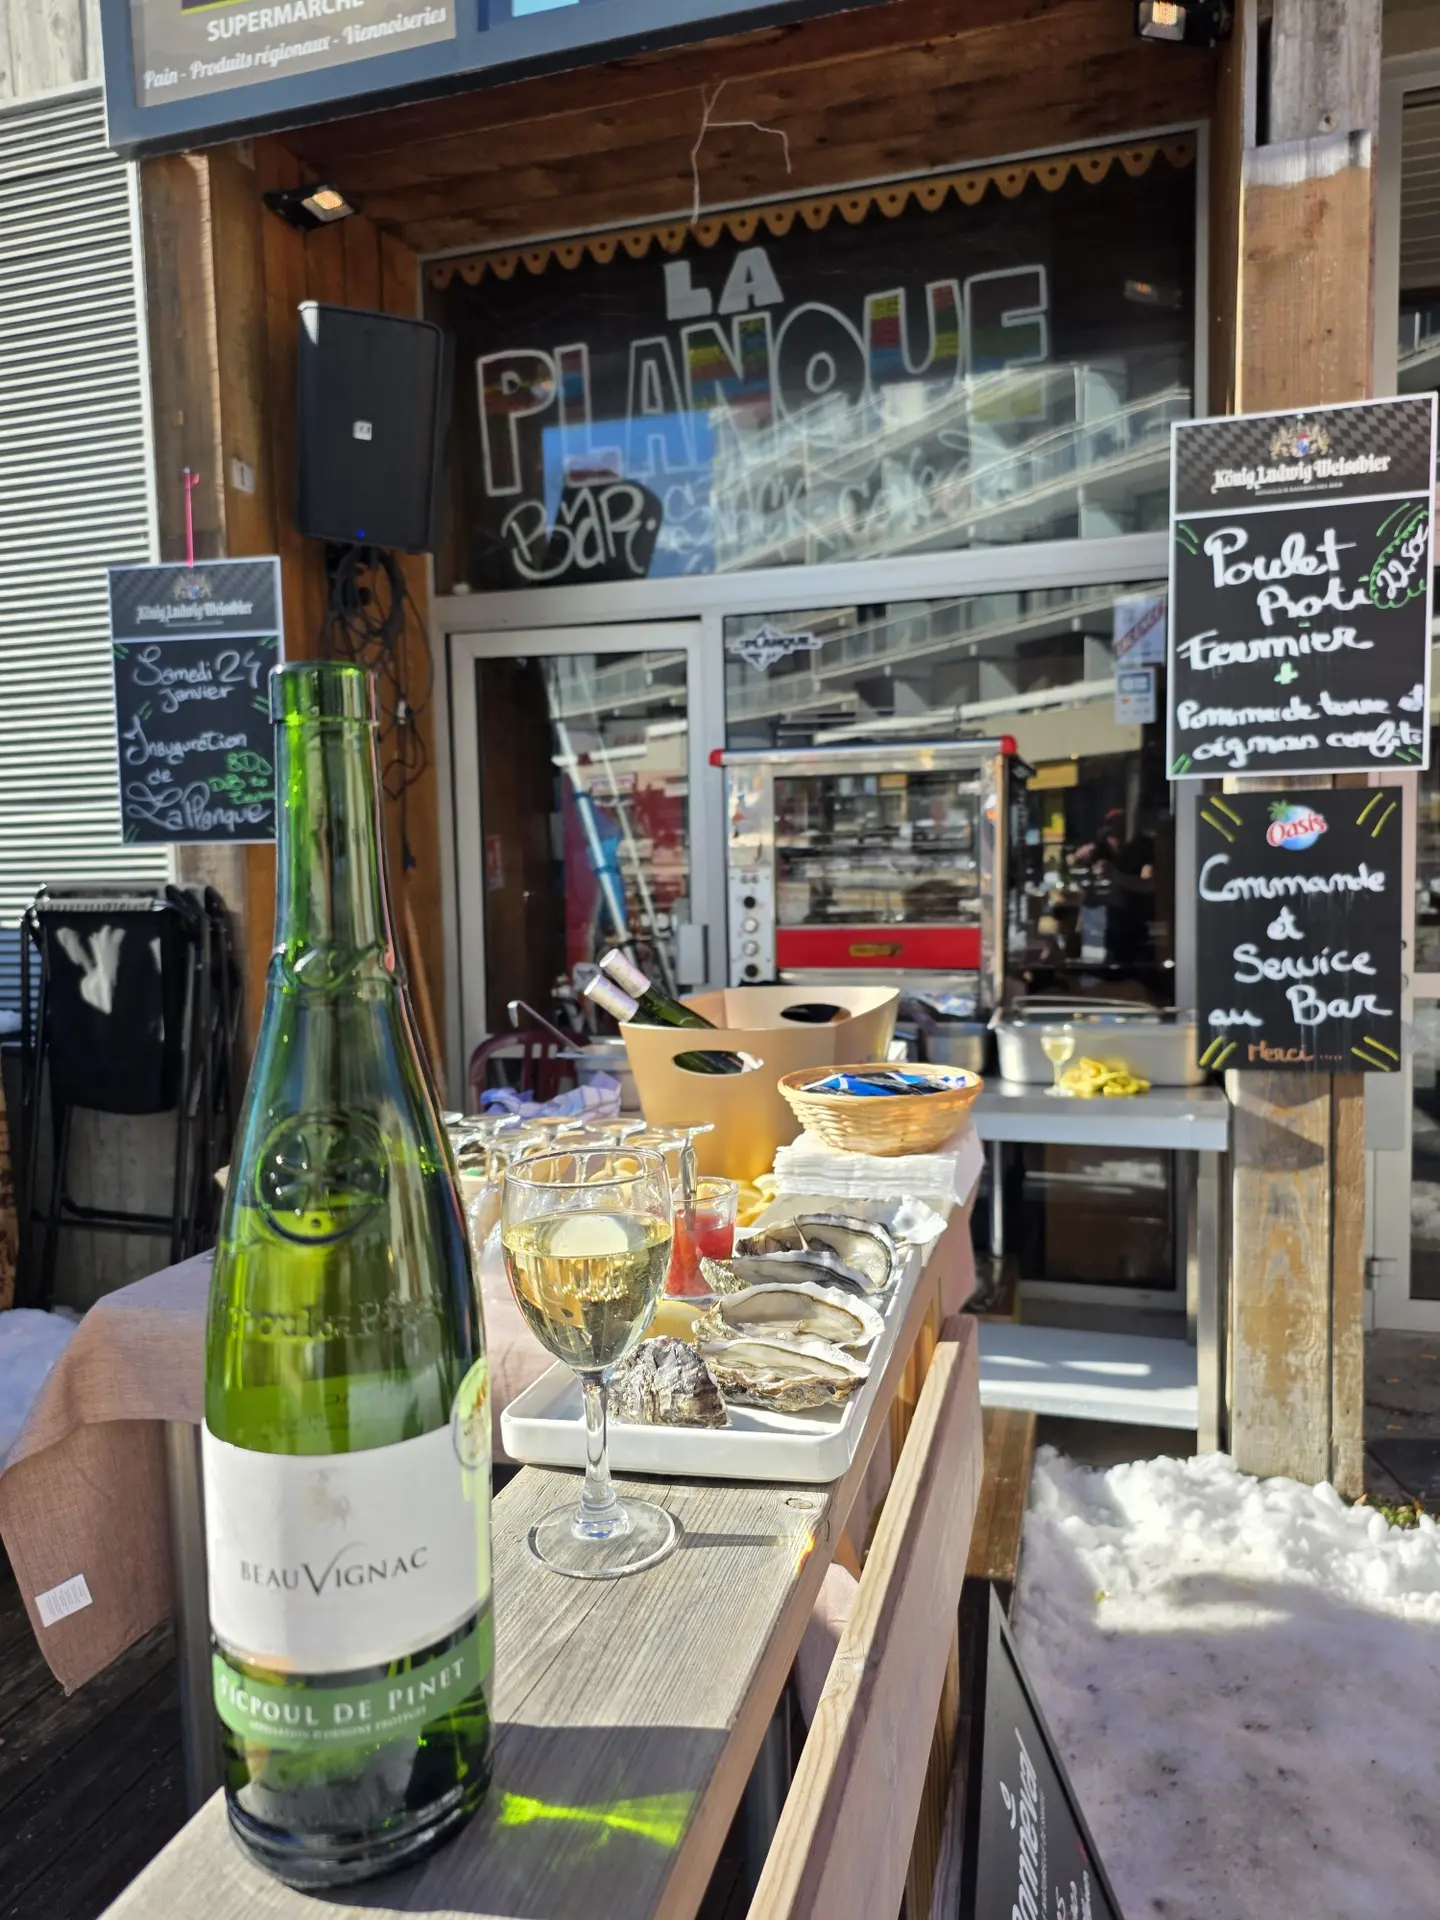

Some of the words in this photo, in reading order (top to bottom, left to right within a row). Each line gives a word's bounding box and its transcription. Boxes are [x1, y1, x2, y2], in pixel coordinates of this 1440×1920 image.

[143, 67, 179, 90] Pain
[189, 52, 253, 80] Produits
[254, 36, 331, 68] régionaux
[341, 6, 447, 45] Viennoiseries
[663, 246, 785, 320] LA
[476, 265, 1048, 497] PLANQUE
[1254, 460, 1313, 490] Ludwig
[1204, 526, 1357, 588] Poulet
[132, 644, 213, 687] Samedi
[213, 649, 263, 690] 24
[1175, 622, 1375, 671] Fermier
[1281, 695, 1321, 722] de
[1325, 719, 1423, 759] confits
[147, 767, 175, 786] de
[1266, 811, 1329, 848] Oasis
[1199, 852, 1386, 902] Commande
[1266, 905, 1305, 940] et
[1232, 942, 1378, 984] Service
[1207, 1007, 1264, 1027] au
[1285, 983, 1393, 1027] Bar
[333, 1698, 373, 1726] DE
[388, 1656, 465, 1713] PINET
[1012, 1727, 1038, 1920] onneval
